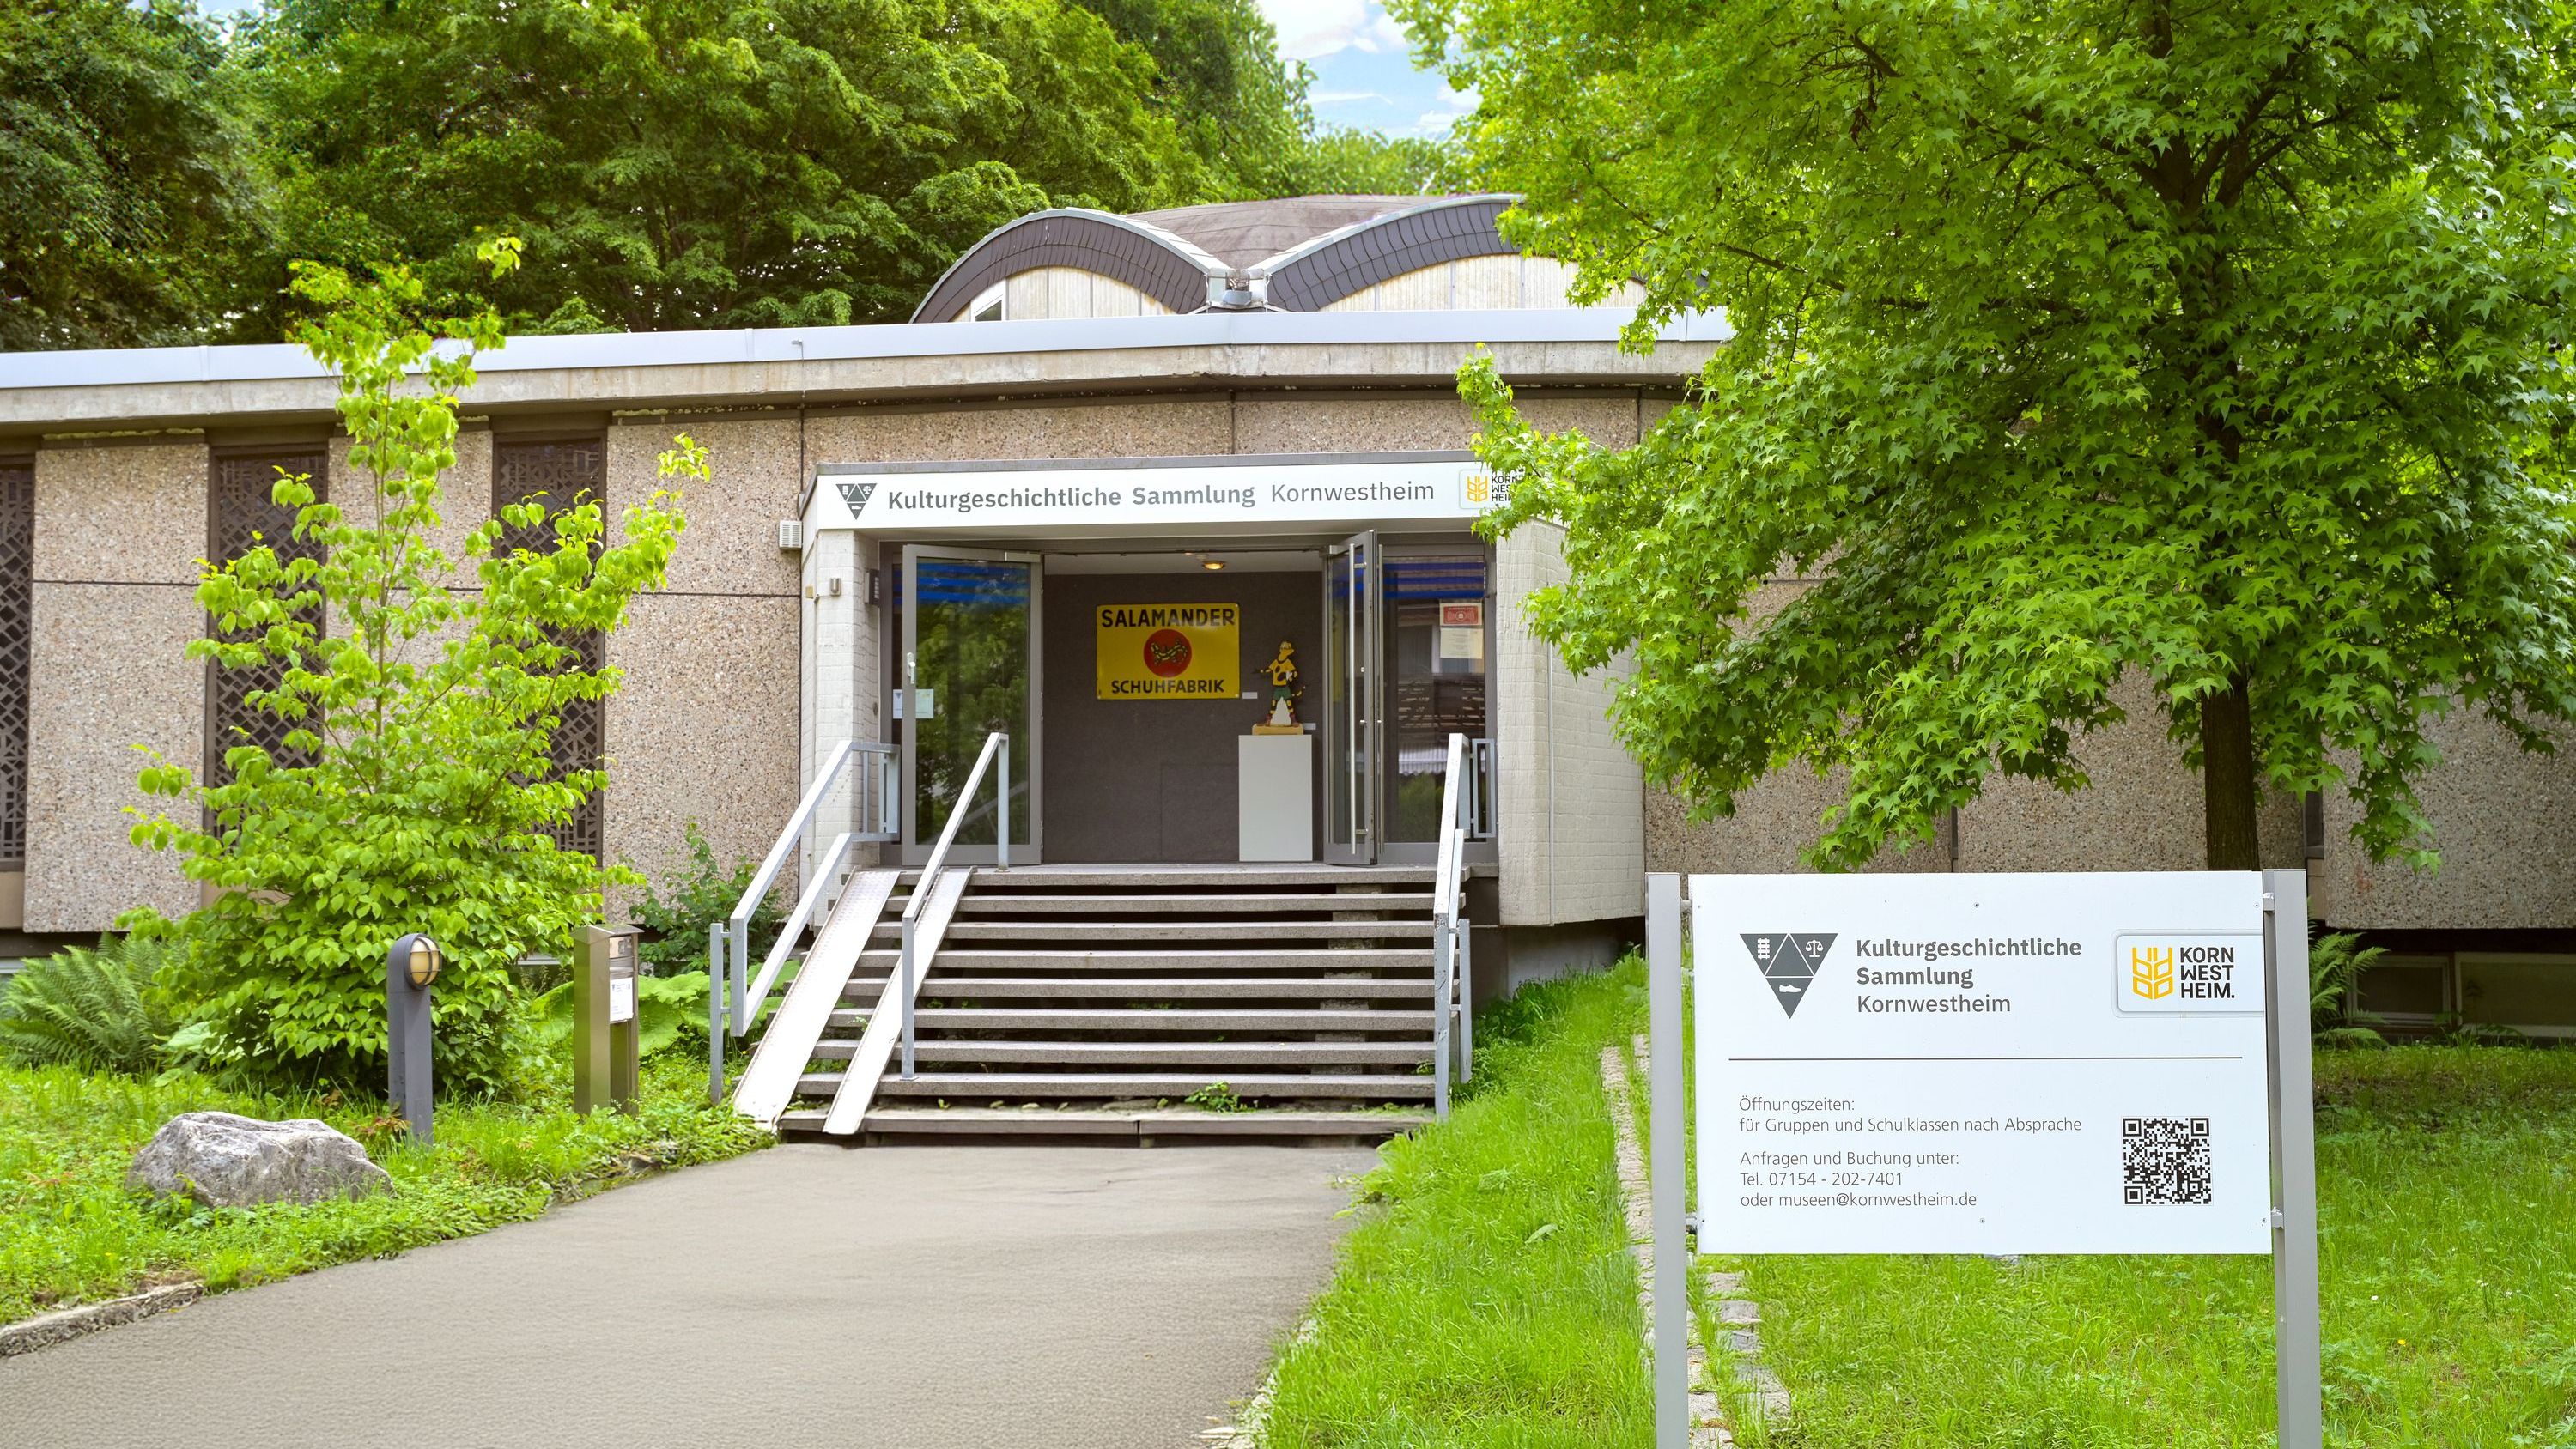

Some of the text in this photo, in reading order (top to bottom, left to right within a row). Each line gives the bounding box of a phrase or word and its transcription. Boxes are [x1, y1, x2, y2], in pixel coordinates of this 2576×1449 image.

[889, 481, 1435, 513] Kulturgeschichtliche Sammlung Kornwestheim
[1491, 484, 1511, 493] WES
[1101, 609, 1236, 627] SALAMANDER
[1111, 680, 1225, 694] SCHUHFABRIK
[1856, 937, 2083, 961] Kulturgeschichtliche
[2180, 947, 2235, 963] KORN
[1856, 966, 1974, 990] Sammlung
[2180, 964, 2235, 981] WEST
[2180, 982, 2236, 999] HEIM.
[1857, 993, 2012, 1013] Kornwestheim
[1739, 1095, 1855, 1114] Öffnungszeiten:
[1739, 1116, 2082, 1135] für Gruppen und Schulklassen nach Absprache
[1740, 1151, 1959, 1168] Anfragen und Buchung unter:
[1740, 1172, 1763, 1186] Tel.
[1769, 1172, 1817, 1186] 07154
[1832, 1172, 1902, 1185] 202-7401
[1741, 1191, 1978, 1207] oder museen@kornwestheim.de
